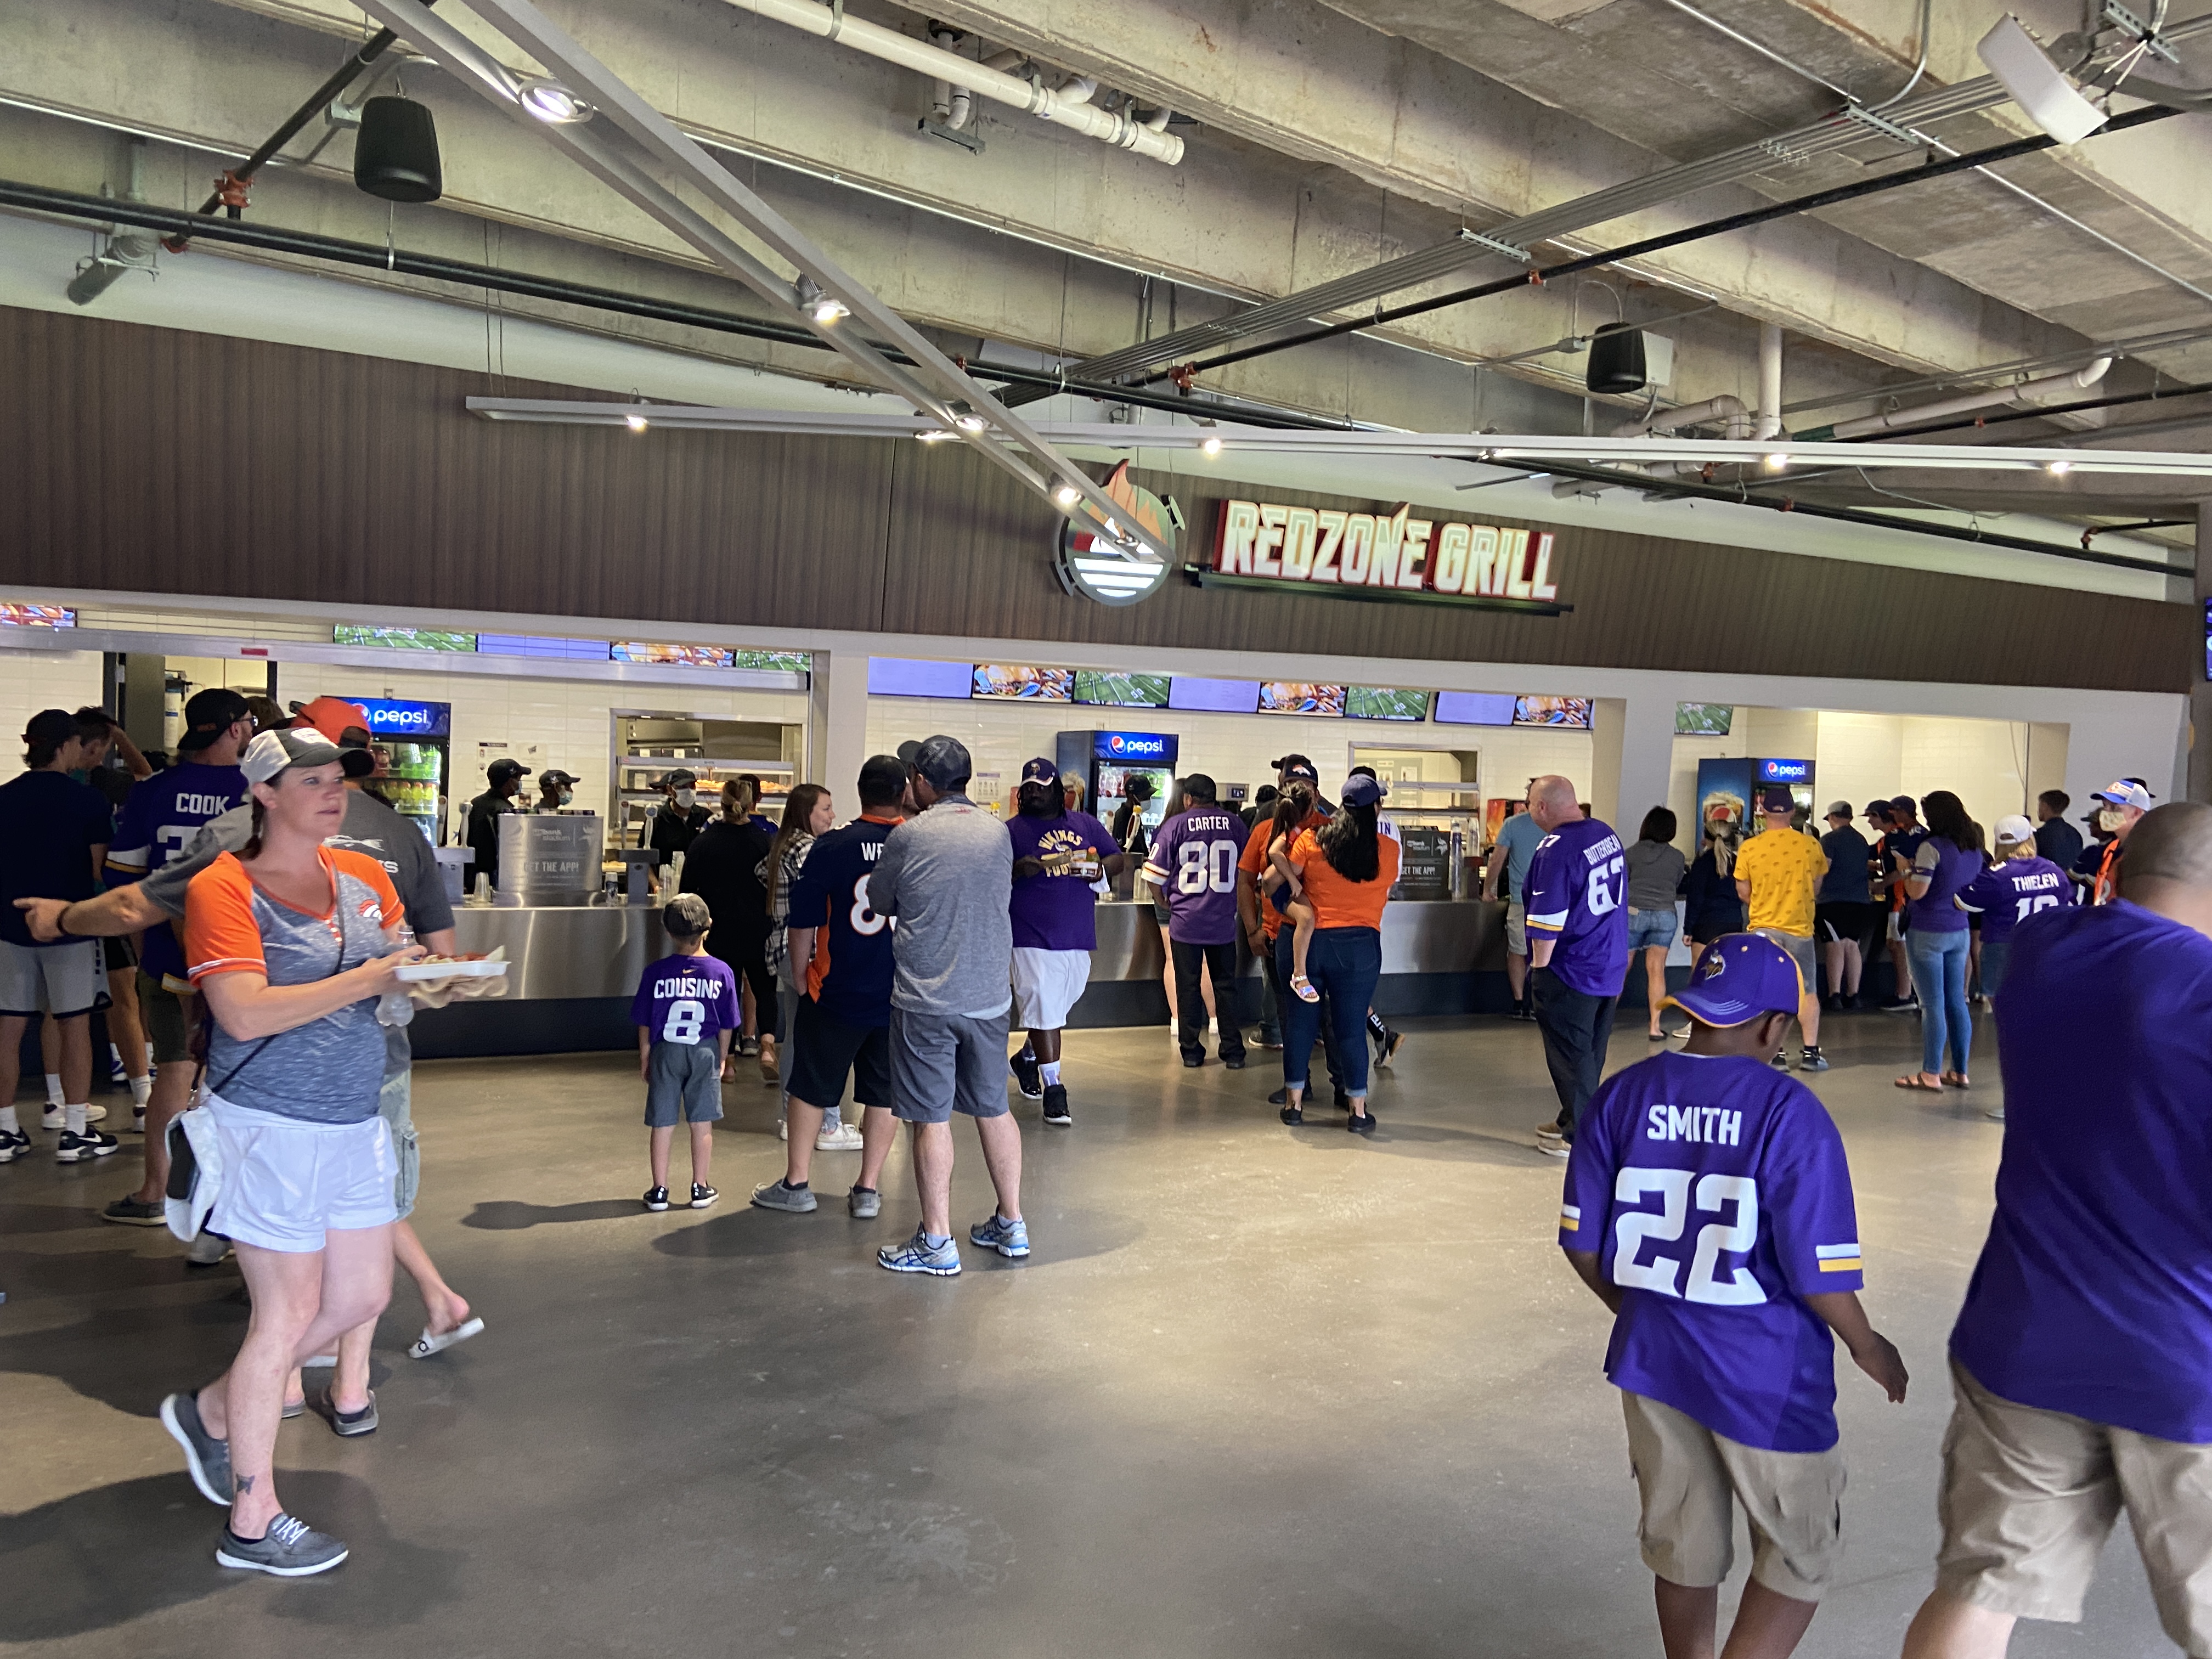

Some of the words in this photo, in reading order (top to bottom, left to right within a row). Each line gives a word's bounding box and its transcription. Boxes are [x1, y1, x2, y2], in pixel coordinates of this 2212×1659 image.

[1218, 500, 1433, 590] REDZONE
[1434, 522, 1556, 601] GRILL
[374, 708, 427, 726] pepsi
[1127, 739, 1163, 754] pepsi
[1779, 765, 1806, 777] pepsi
[176, 792, 230, 816] COOK
[1187, 816, 1230, 832] CARTER
[1038, 830, 1084, 851] VIKINGS
[542, 861, 557, 873] THE
[559, 861, 579, 872] APP!
[1178, 839, 1238, 894] 80
[1401, 866, 1410, 875] GET
[1412, 866, 1422, 875] THE
[1423, 866, 1436, 876] APP!
[1587, 855, 1624, 917] 67
[2011, 872, 2059, 893] THIELEN
[850, 872, 898, 936] 8
[653, 977, 723, 1000] COUSINS
[663, 1000, 706, 1046] 8
[1647, 1104, 1742, 1146] SMITH
[1613, 1166, 1768, 1306] 22
